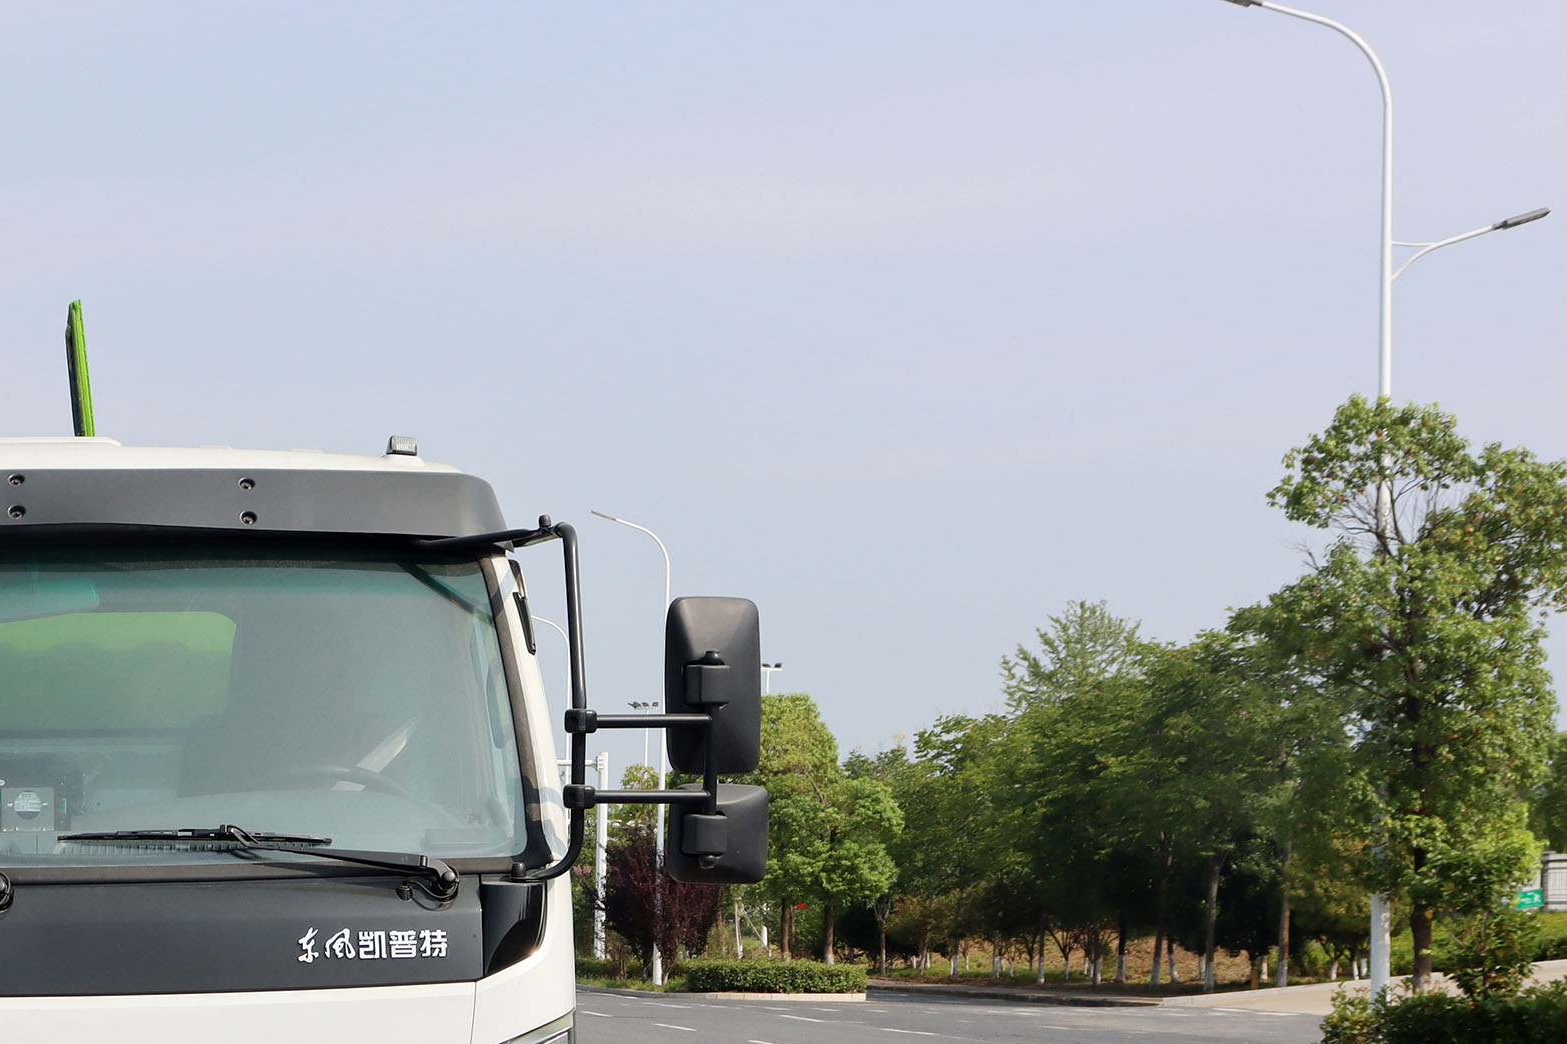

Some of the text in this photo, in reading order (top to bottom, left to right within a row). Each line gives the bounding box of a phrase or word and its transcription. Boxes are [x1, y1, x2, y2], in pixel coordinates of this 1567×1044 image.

[297, 926, 449, 964] 东风凯普特
